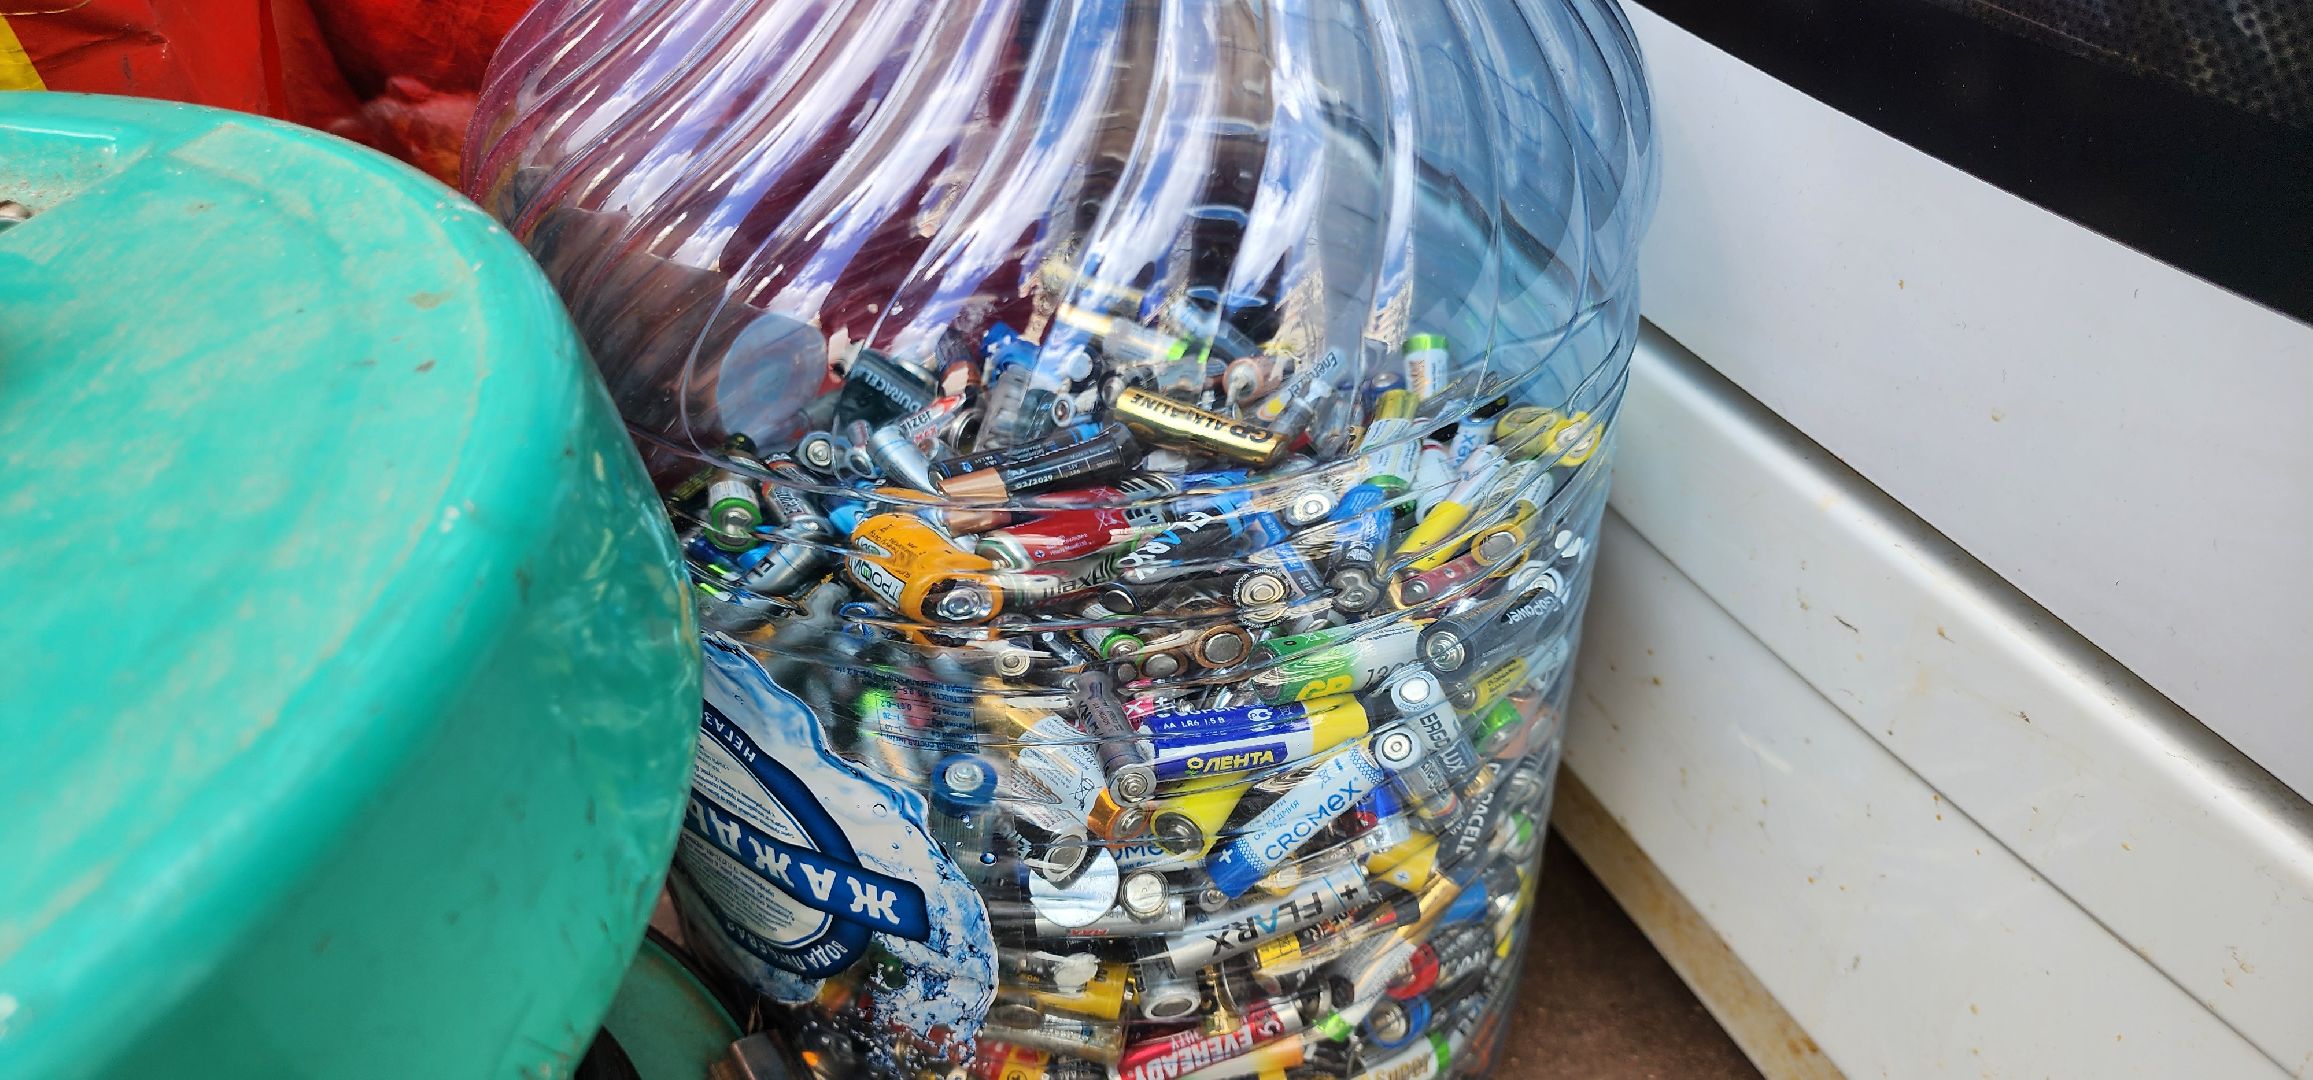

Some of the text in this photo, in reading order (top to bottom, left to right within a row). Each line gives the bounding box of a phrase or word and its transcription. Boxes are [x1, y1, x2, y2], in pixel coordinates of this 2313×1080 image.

[1288, 352, 1338, 399] Enerer
[1130, 392, 1228, 431] ALKLINE
[1295, 674, 1354, 701] GP
[1163, 722, 1176, 730] AA
[1203, 751, 1277, 773] ЛЕНТА
[1205, 890, 1324, 958] FLARX
[805, 938, 849, 970] ВОДА
[1133, 1022, 1255, 1080] EVEREADY
